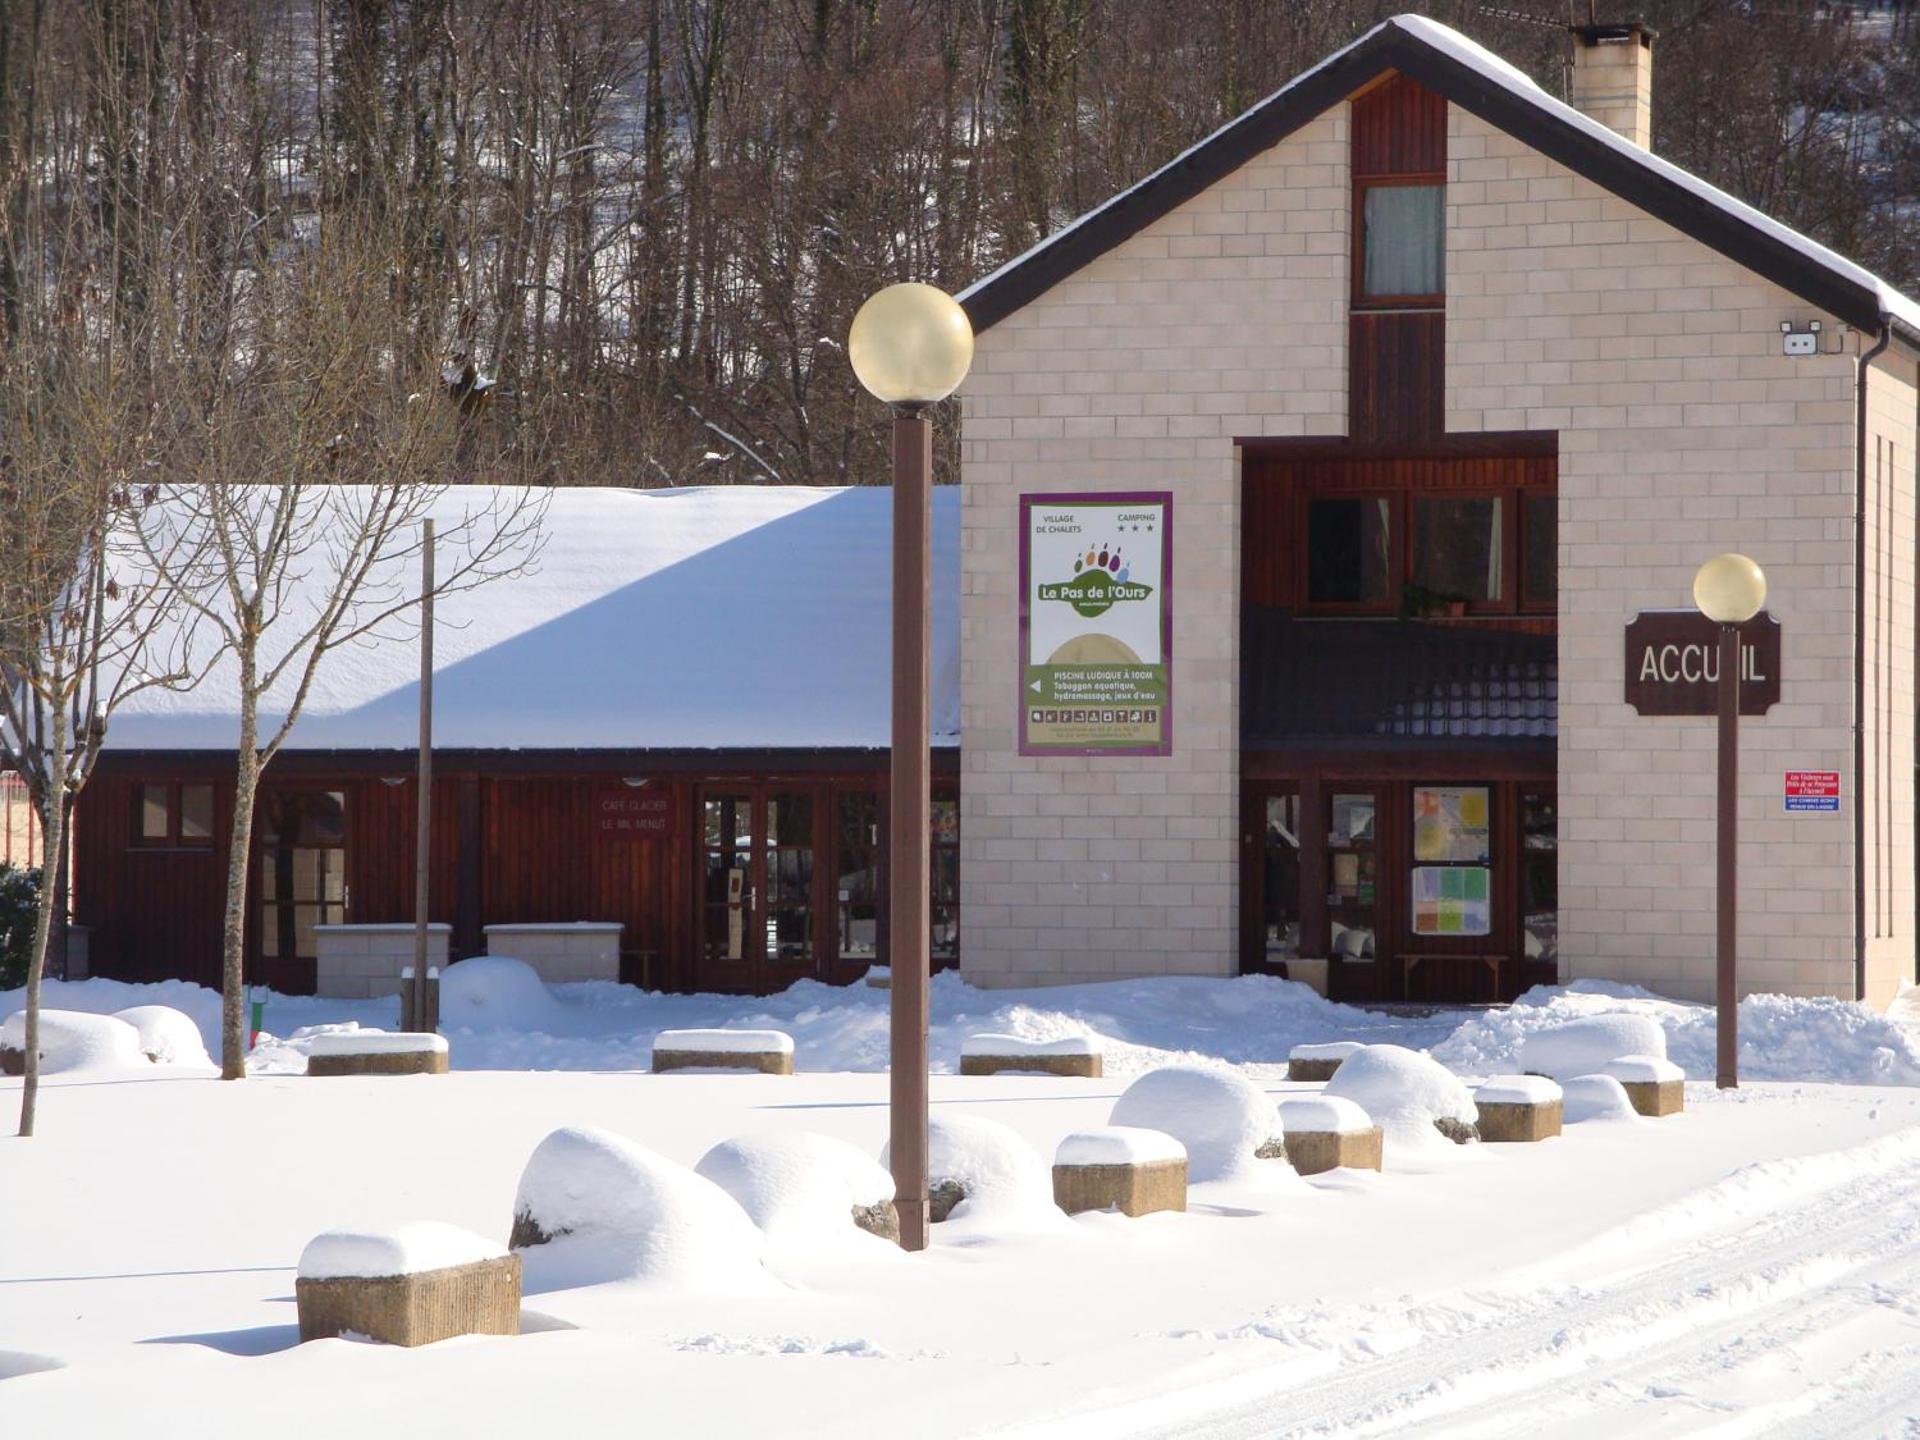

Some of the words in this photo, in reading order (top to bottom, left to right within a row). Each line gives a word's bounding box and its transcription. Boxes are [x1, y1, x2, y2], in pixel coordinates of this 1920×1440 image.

[1043, 515, 1074, 523] VILLAGE
[1118, 514, 1155, 522] CAMPING
[1036, 526, 1048, 534] DE
[1048, 525, 1082, 534] CHALETS
[1042, 587, 1057, 599] Le
[1061, 586, 1084, 599] Pas
[1087, 586, 1104, 598] de
[1108, 586, 1146, 598] l'Ours
[1639, 644, 1766, 682] ACCUIL
[1054, 671, 1084, 680] PISCINE
[1087, 671, 1121, 680] LUDIQUE
[1132, 671, 1153, 680] 100M
[1114, 692, 1132, 701] jeux
[1133, 692, 1155, 700] d'eau
[602, 819, 614, 830] LE
